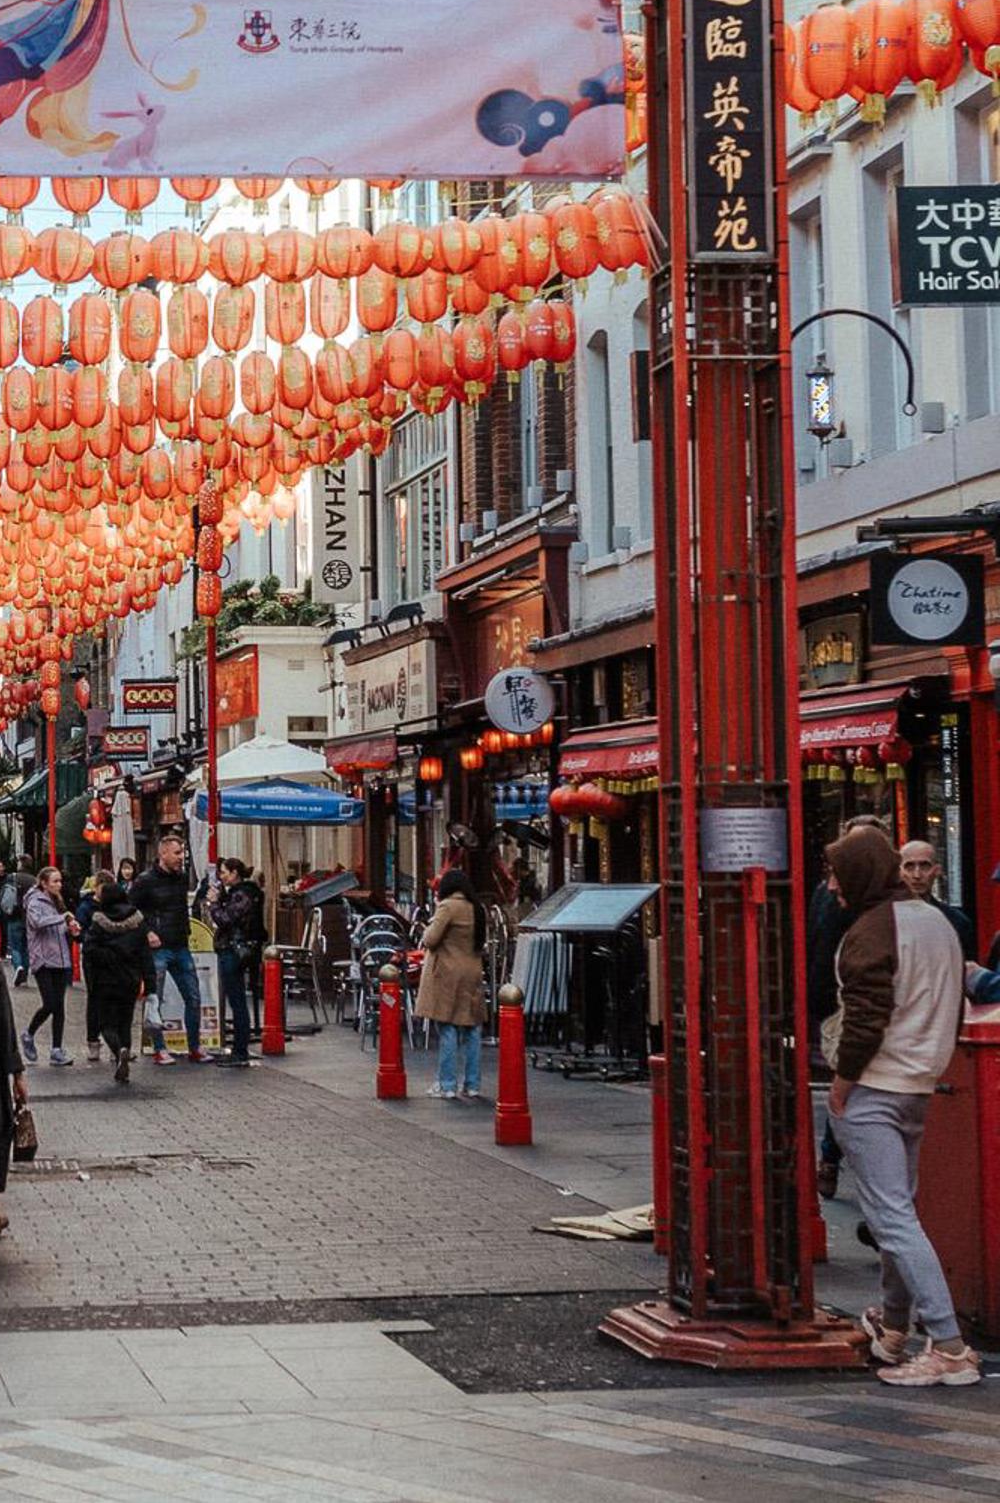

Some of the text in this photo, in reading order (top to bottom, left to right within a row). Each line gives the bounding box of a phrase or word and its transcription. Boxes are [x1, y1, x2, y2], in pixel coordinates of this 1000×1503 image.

[919, 269, 1000, 290] Hair Sal
[900, 586, 962, 599] Chatime
